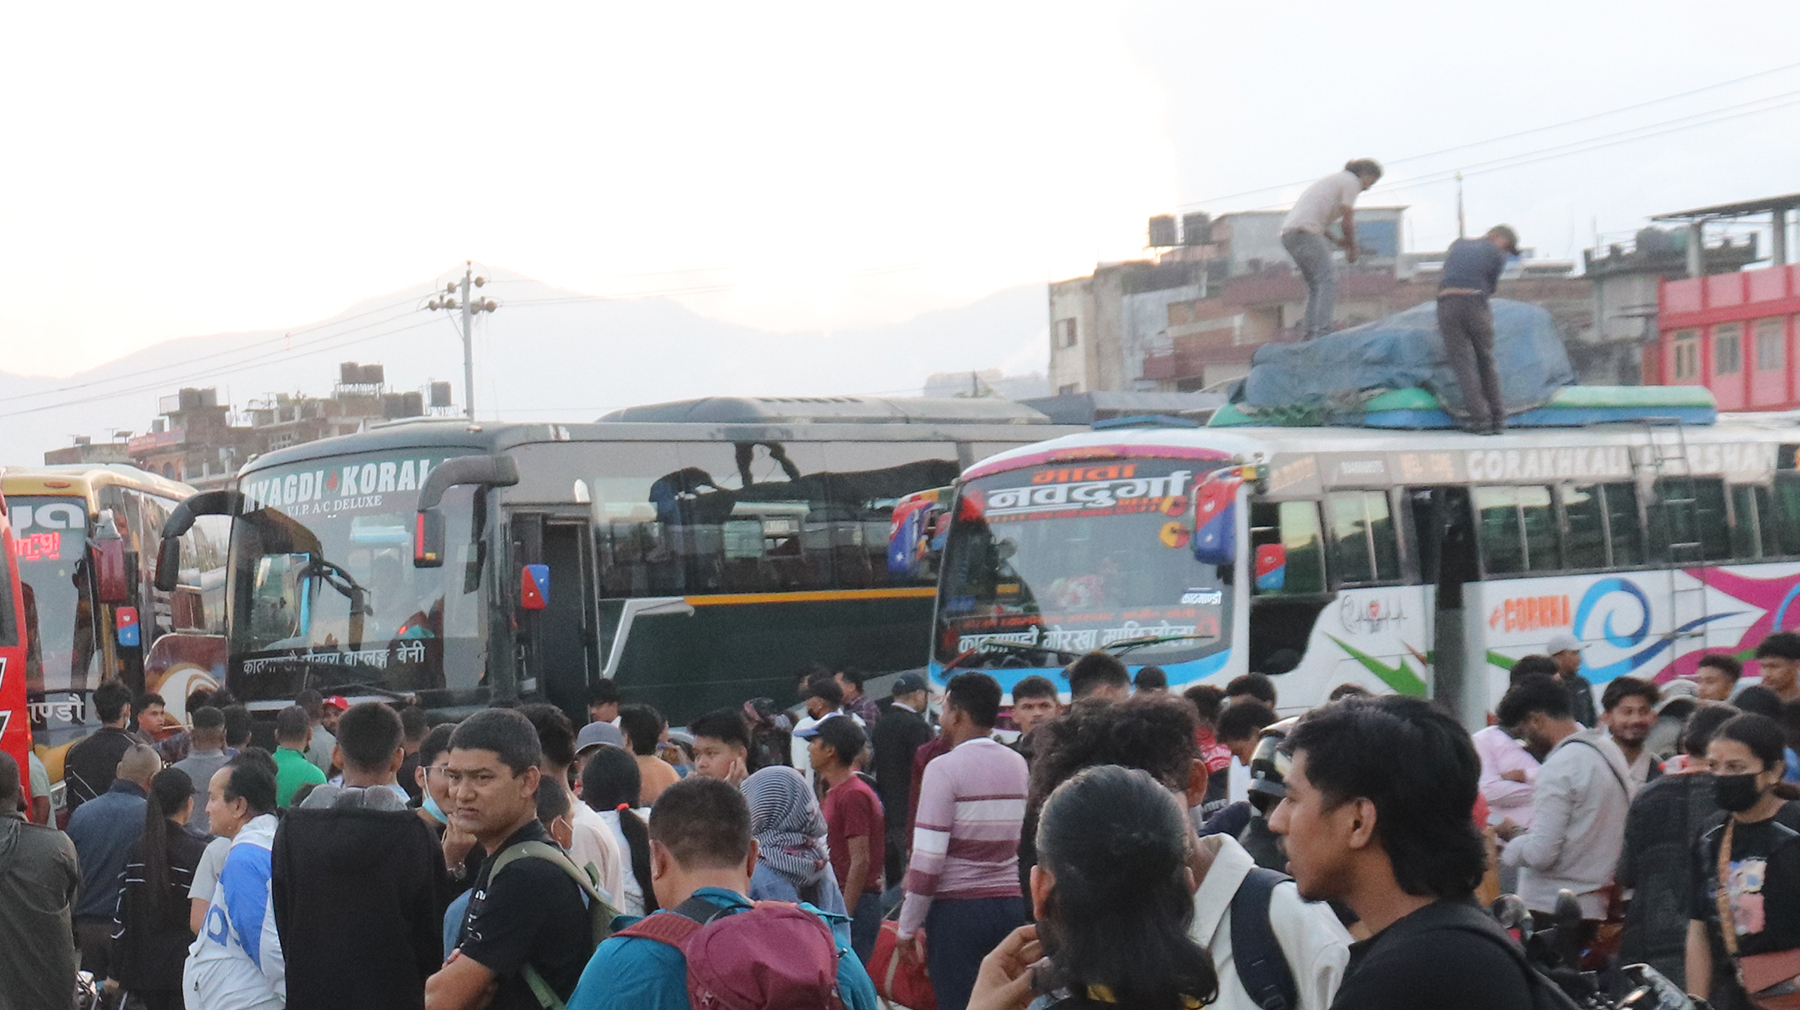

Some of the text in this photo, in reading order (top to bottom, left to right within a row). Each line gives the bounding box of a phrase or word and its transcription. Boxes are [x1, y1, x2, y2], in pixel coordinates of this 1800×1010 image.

[242, 470, 324, 515] MYAGDI
[333, 495, 383, 511] DELUXE
[988, 470, 1192, 508] नवदुर्गा
